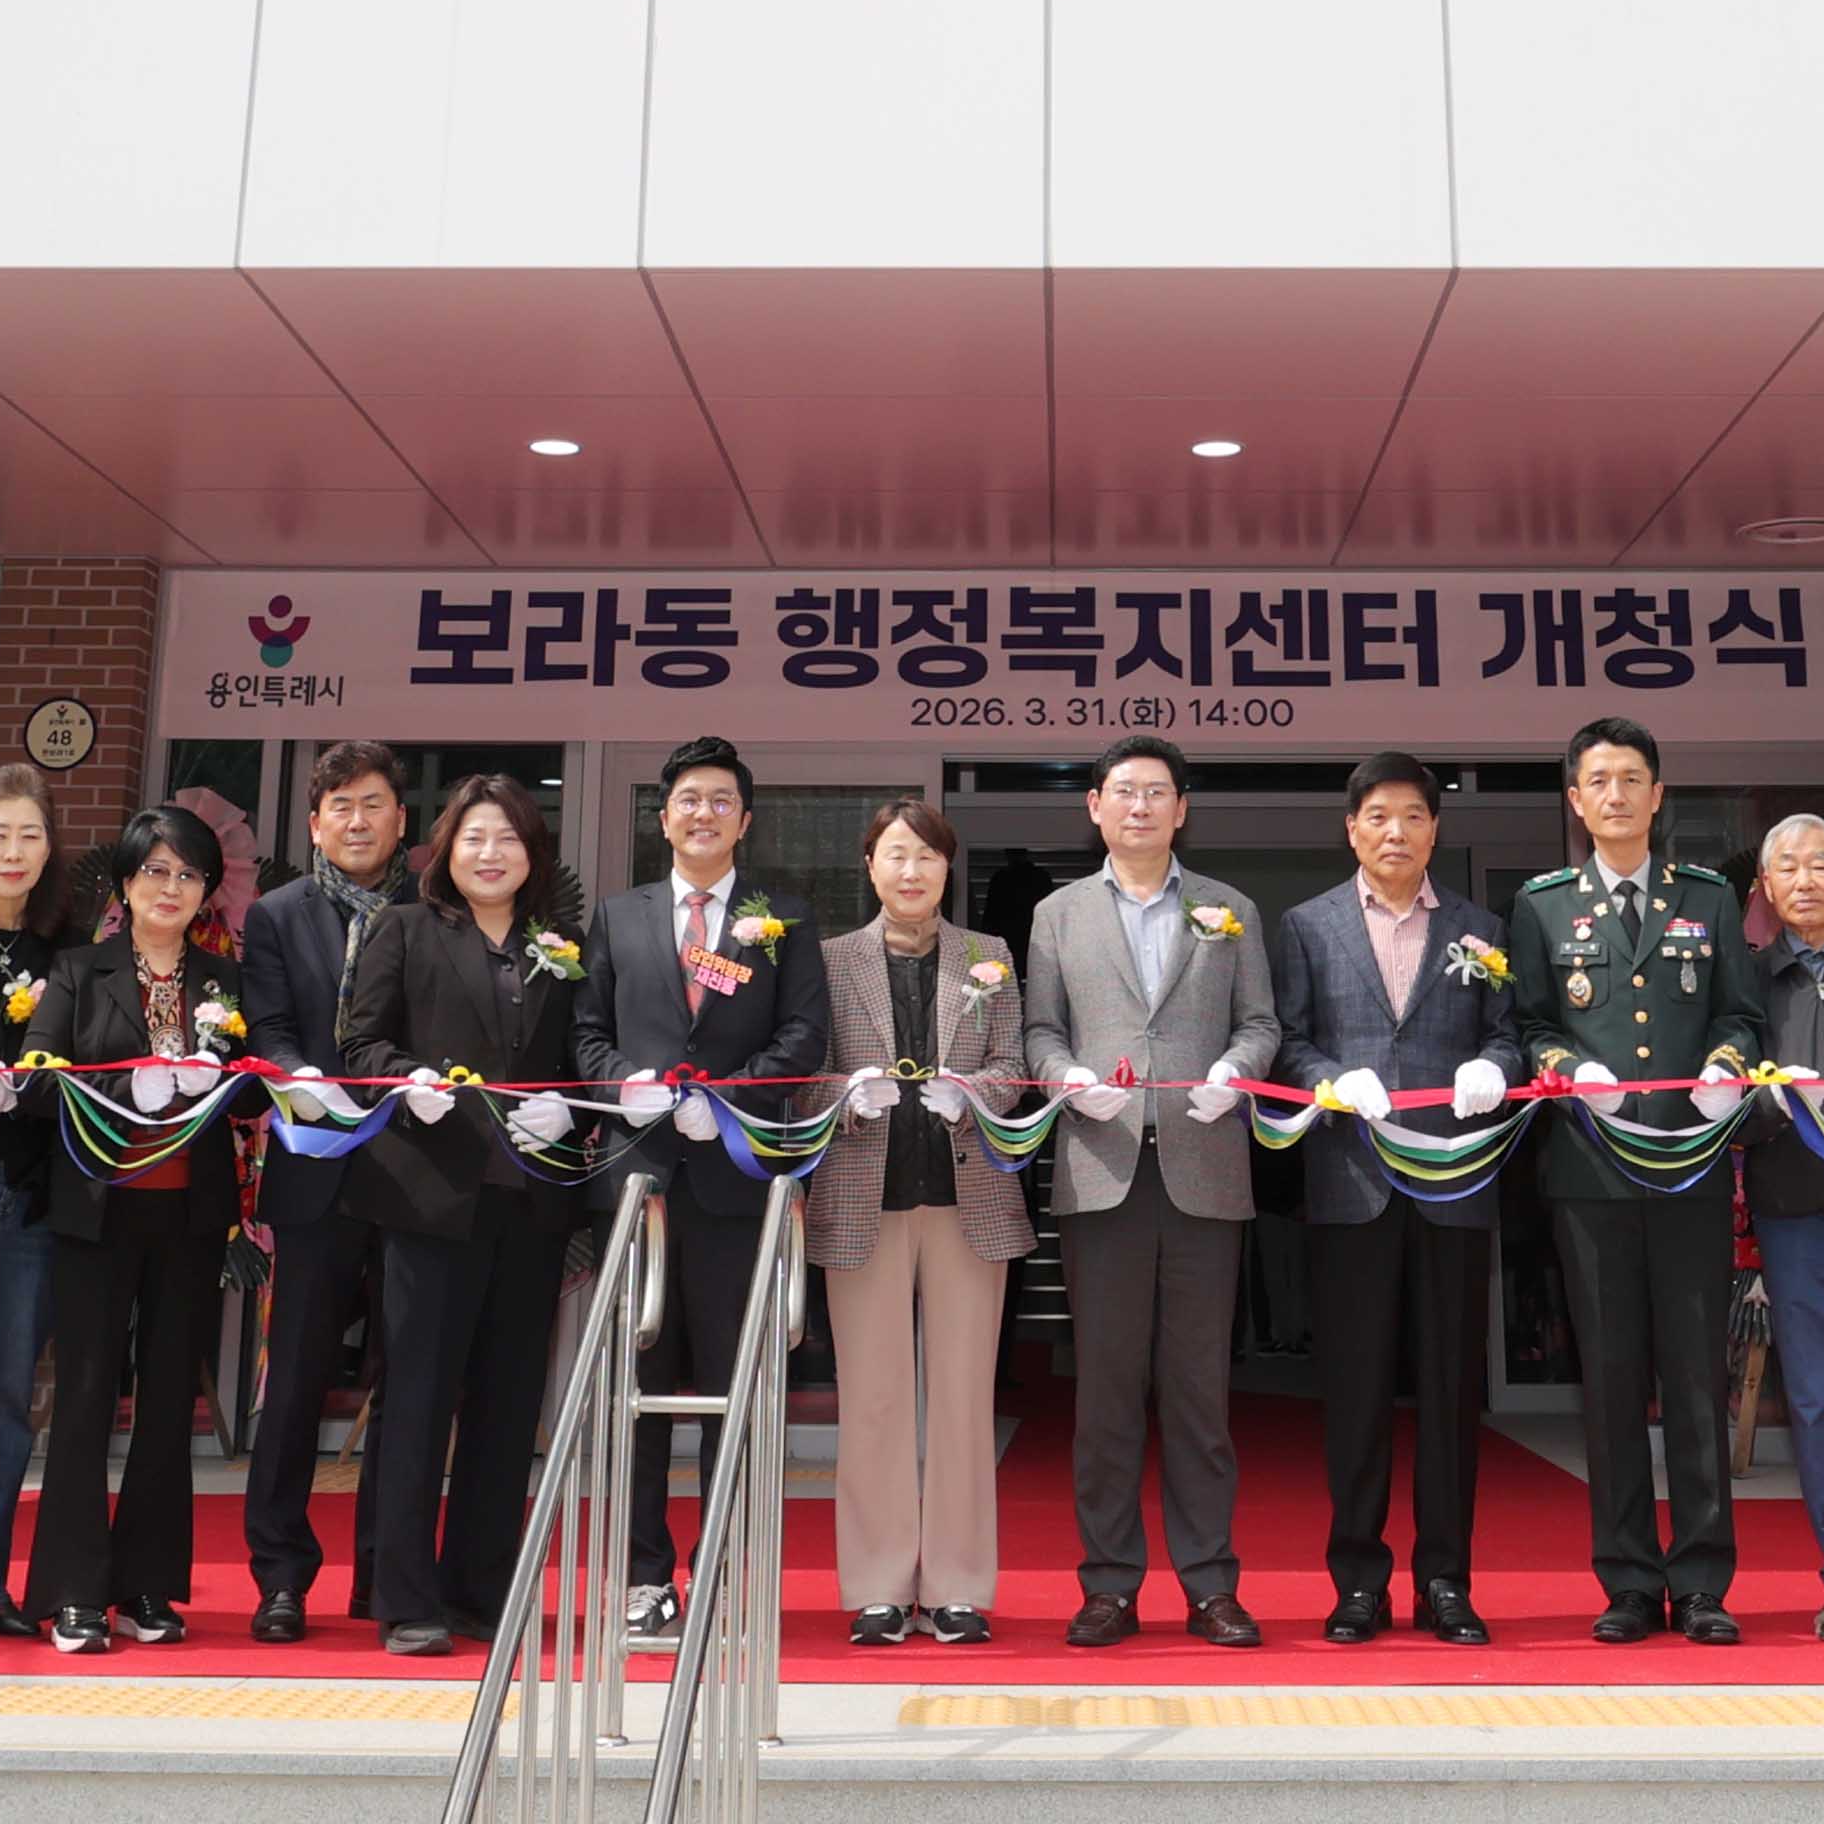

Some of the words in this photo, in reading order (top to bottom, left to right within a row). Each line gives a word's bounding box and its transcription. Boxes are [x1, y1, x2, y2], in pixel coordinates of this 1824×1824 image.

[410, 588, 739, 689] 보라동
[776, 586, 1440, 689] 행정복지센터
[1480, 587, 1808, 690] 개청식
[205, 672, 344, 709] 용인특례시
[910, 697, 1014, 726] 2026.
[1025, 697, 1055, 726] 3.
[1066, 697, 1176, 729] 31.(화)
[1188, 698, 1294, 727] 14:00
[47, 729, 73, 746] 48
